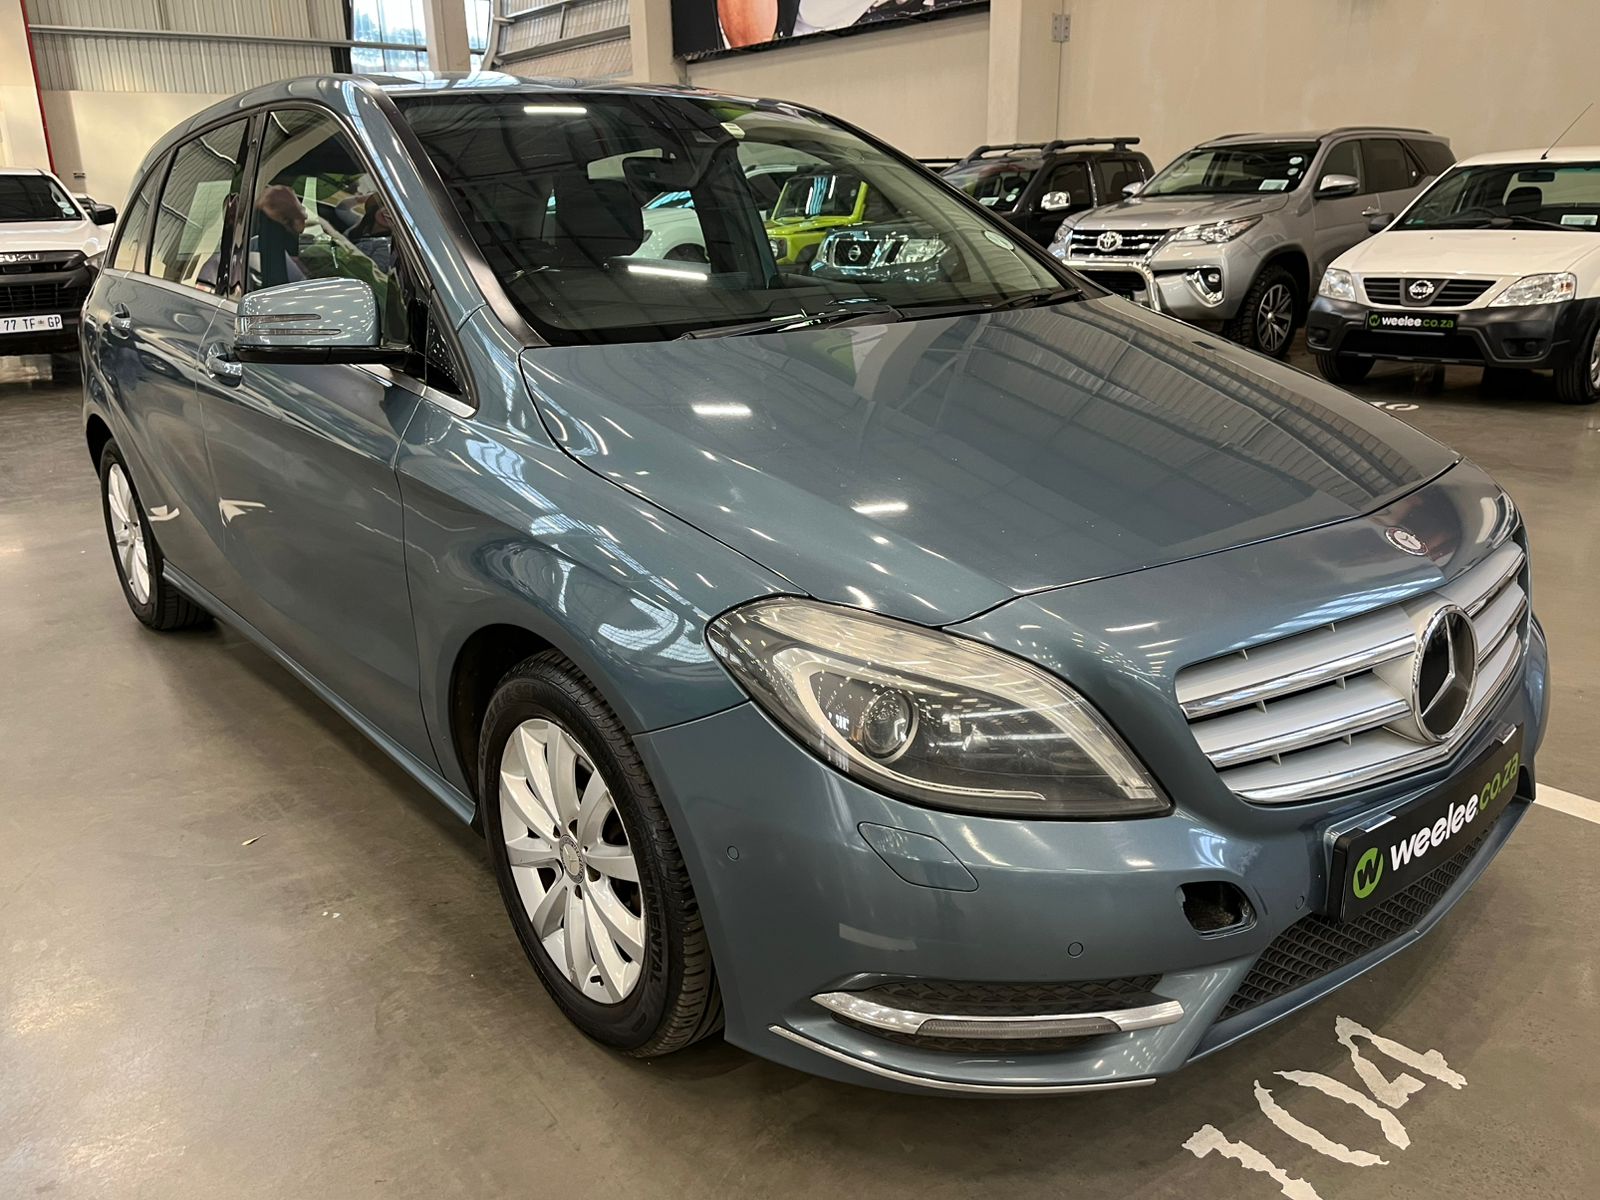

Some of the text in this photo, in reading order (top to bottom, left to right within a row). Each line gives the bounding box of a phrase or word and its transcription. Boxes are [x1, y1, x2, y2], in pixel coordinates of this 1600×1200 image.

[4, 316, 61, 331] 77 TF GP
[1382, 315, 1454, 328] weelee.co.za
[1390, 753, 1520, 871] weelee.co.za
[1182, 1015, 1468, 1200] 104
